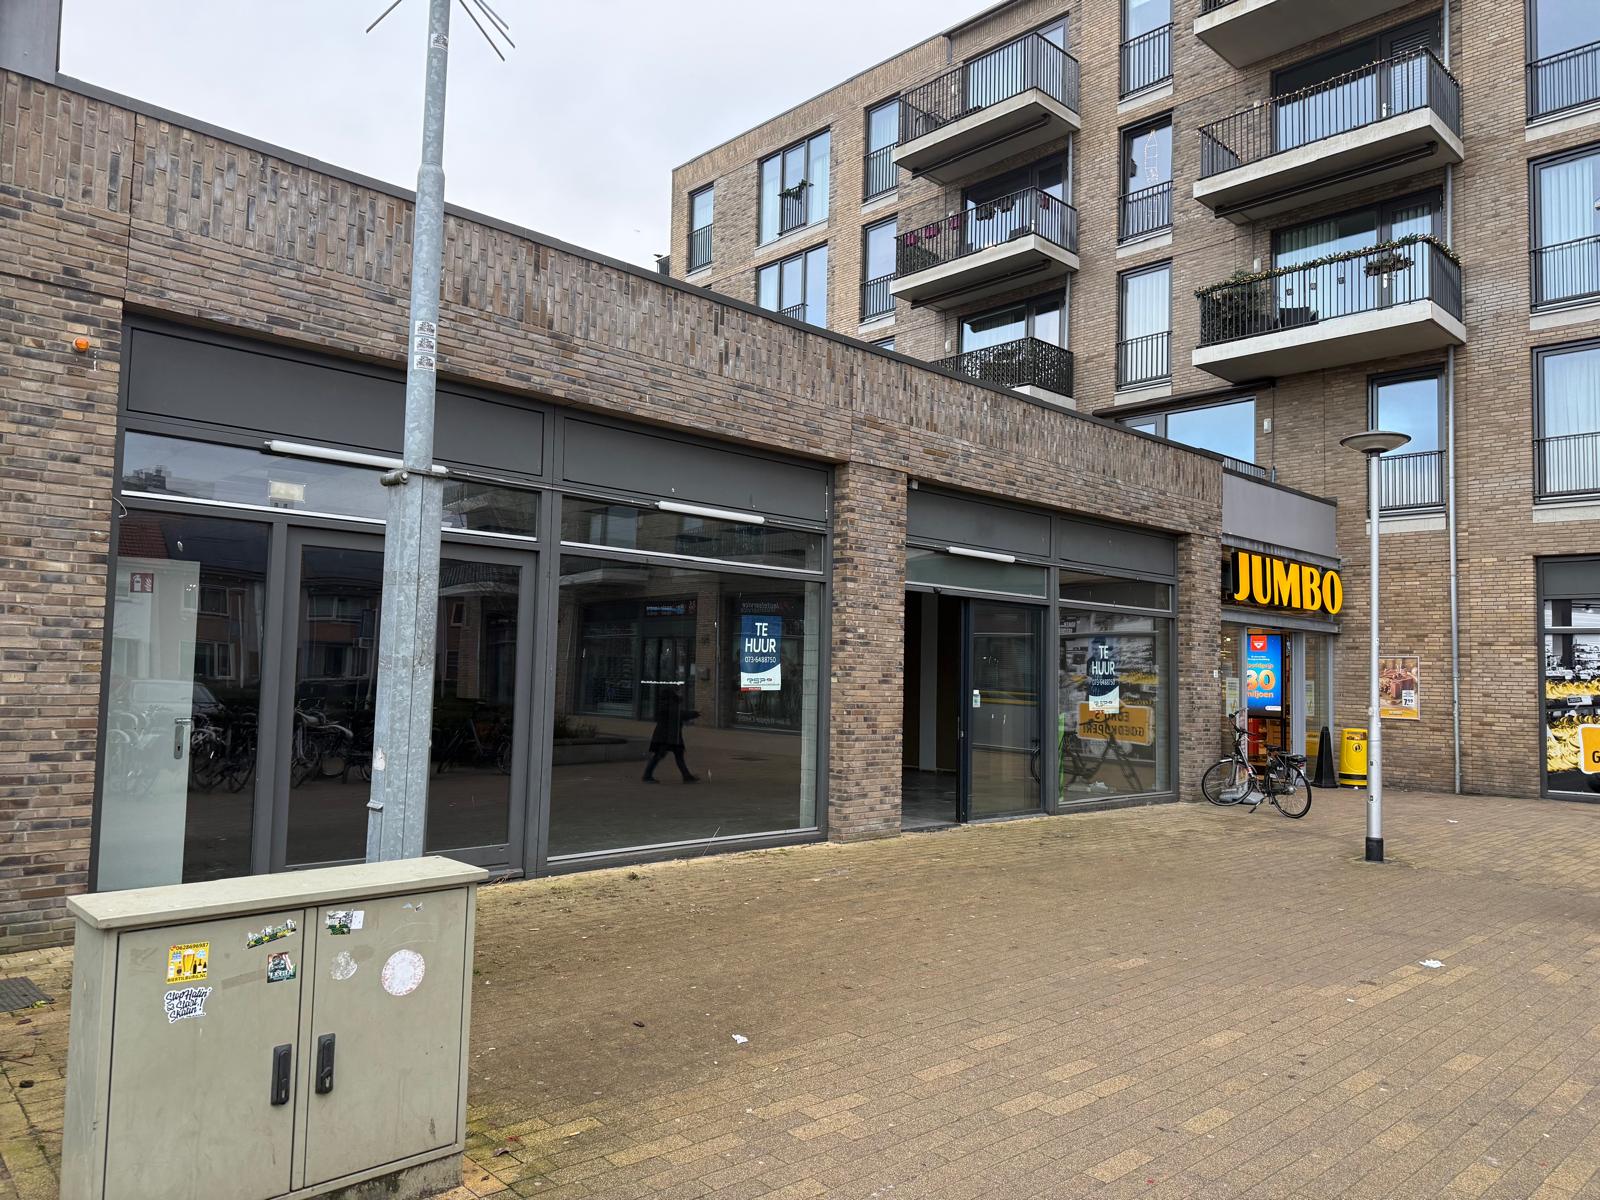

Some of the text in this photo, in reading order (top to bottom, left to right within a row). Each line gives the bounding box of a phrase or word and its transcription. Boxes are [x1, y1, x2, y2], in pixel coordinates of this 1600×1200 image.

[1234, 551, 1343, 615] JUMBO
[755, 622, 768, 636] TE
[745, 638, 776, 653] HUUR
[1099, 645, 1109, 659] TE
[1091, 661, 1115, 675] HUUR
